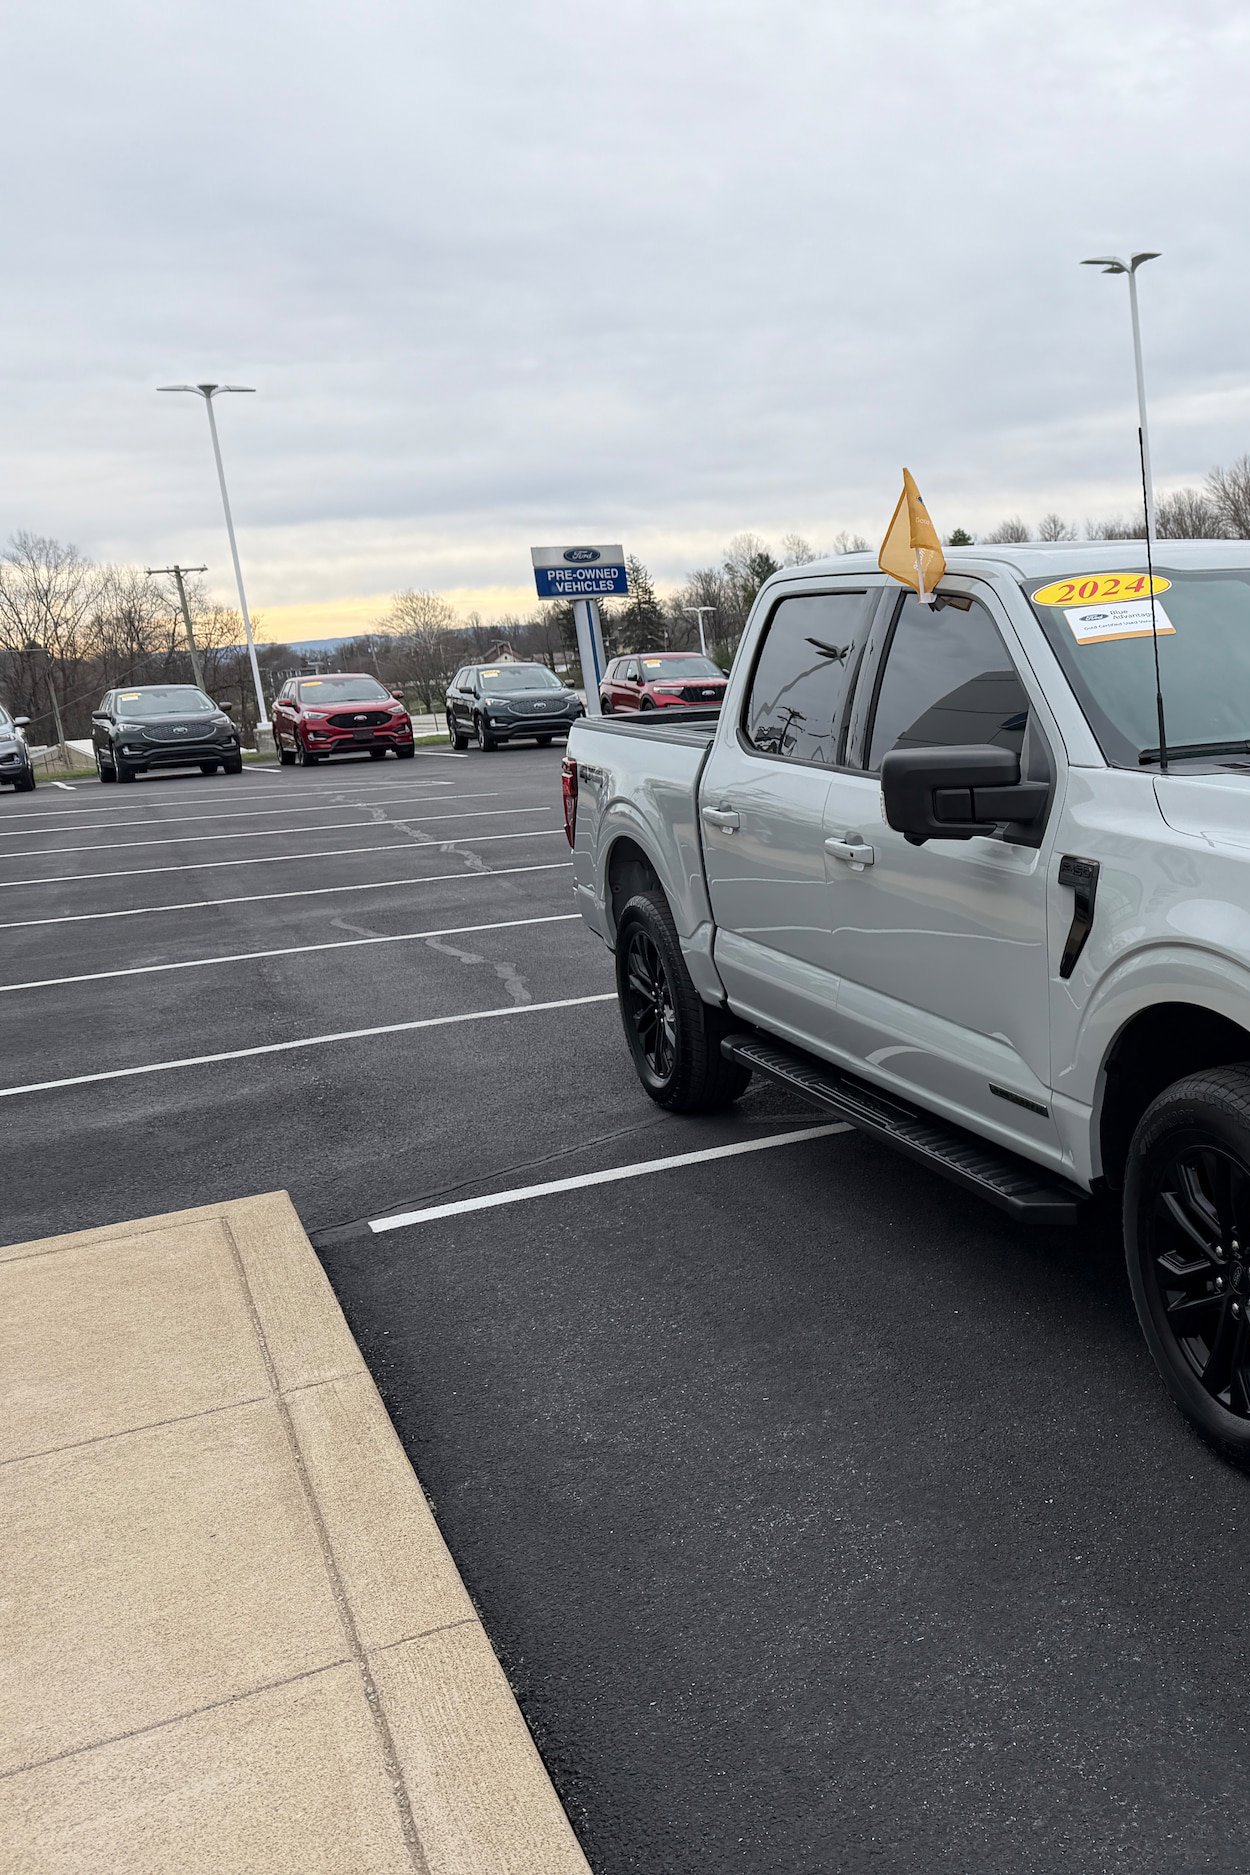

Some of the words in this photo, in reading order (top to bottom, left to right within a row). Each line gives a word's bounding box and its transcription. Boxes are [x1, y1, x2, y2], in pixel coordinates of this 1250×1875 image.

[571, 550, 593, 560] Ford
[547, 568, 619, 581] PRE-OWNED
[555, 580, 615, 593] VEHICLES
[1054, 576, 1146, 604] 2024
